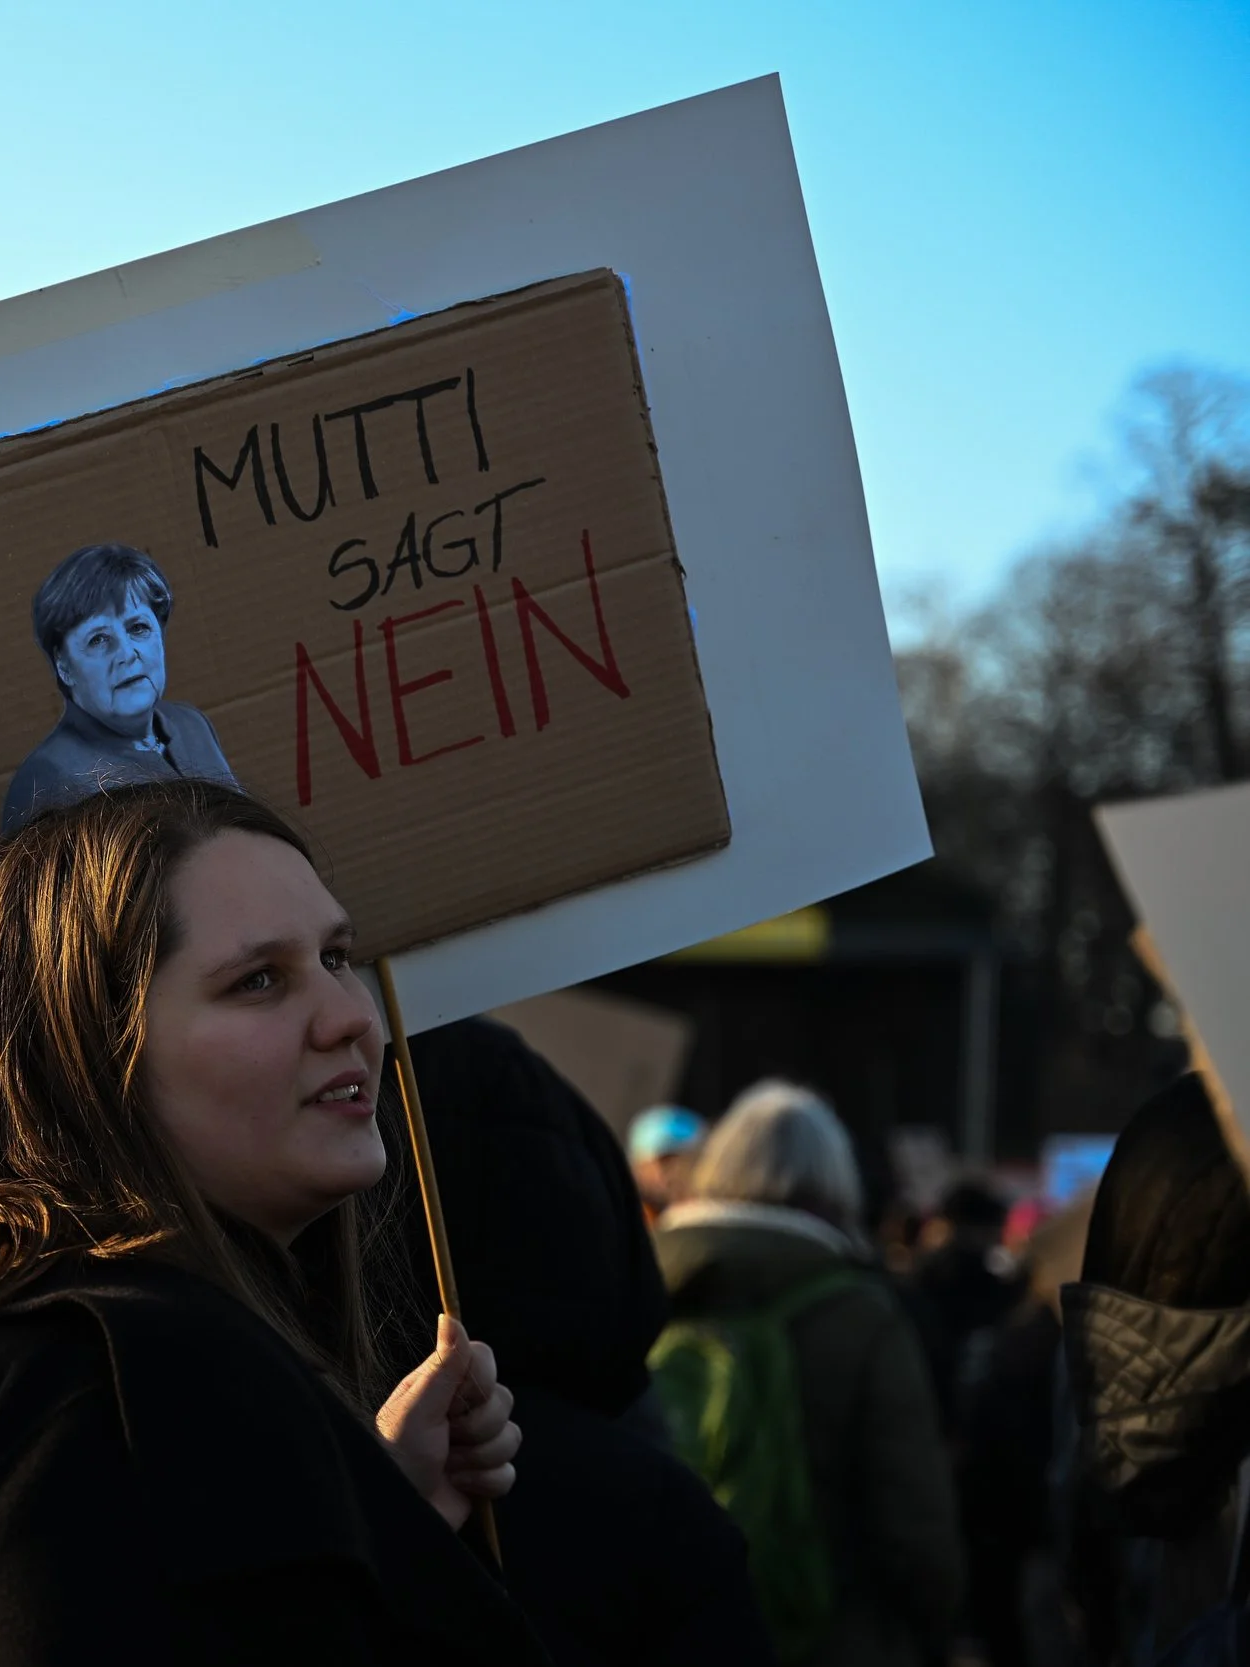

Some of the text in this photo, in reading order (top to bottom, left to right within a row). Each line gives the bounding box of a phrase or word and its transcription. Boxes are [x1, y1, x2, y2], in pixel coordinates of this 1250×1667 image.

[194, 367, 489, 548] MUTTI
[328, 477, 545, 610] SAGT
[295, 529, 630, 806] NEIN
